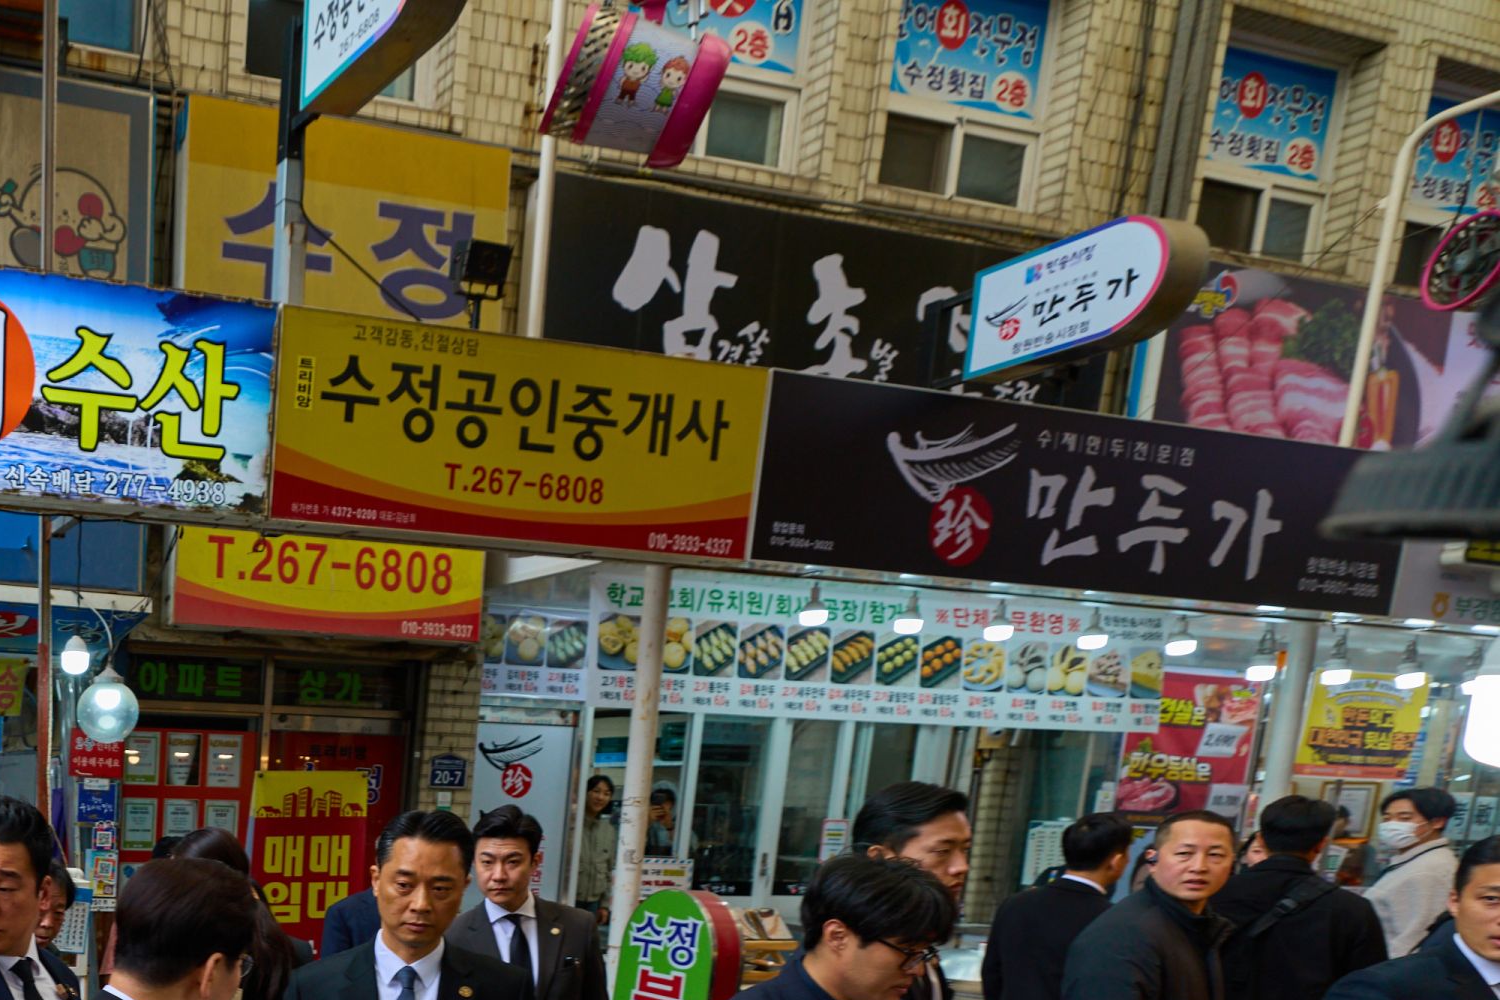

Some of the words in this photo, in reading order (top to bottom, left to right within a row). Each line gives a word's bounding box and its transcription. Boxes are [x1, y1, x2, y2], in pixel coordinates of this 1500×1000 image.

[735, 28, 768, 60] 2층
[904, 60, 987, 100] 수정횟집
[996, 78, 1028, 108] 2층
[1210, 128, 1280, 164] 수정횟집
[1286, 143, 1316, 171] 2층
[1032, 267, 1141, 327] 만두가
[320, 354, 731, 462] 수정공인중개사
[5, 463, 95, 495] 신속배달
[104, 471, 226, 505] 277-4938
[444, 462, 605, 505] T.267-6808
[648, 531, 733, 556] 010-3933-4337
[1026, 464, 1283, 581] 만두가
[208, 534, 453, 596] T.267-6808
[401, 619, 474, 640] 010-3933-4337
[138, 662, 243, 697] 아파트
[299, 669, 364, 705] 상가
[434, 770, 462, 785] 20-7
[1127, 751, 1212, 782] 한우등심은
[263, 835, 351, 877] 매매
[262, 881, 349, 924] 임대
[630, 911, 702, 969] 수정
